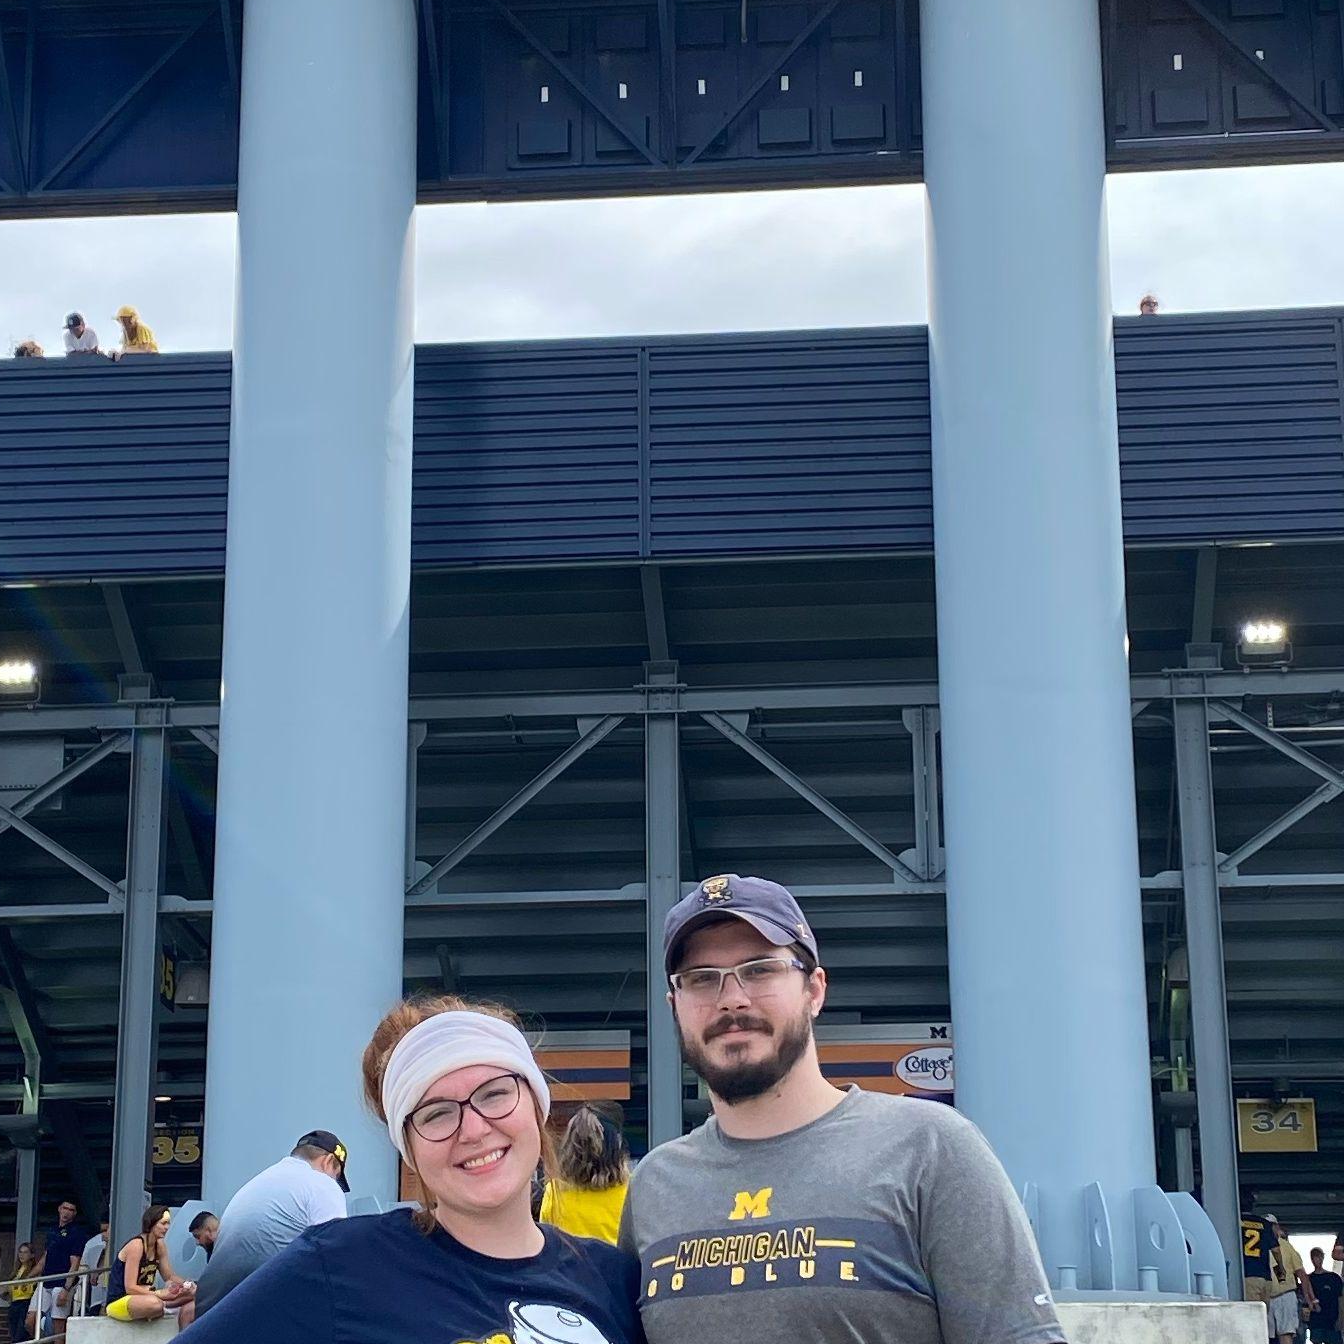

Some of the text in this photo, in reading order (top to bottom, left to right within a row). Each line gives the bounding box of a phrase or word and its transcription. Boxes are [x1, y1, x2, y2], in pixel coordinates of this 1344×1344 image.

[929, 1026, 948, 1039] M
[904, 1055, 951, 1081] Cottage
[1251, 1111, 1304, 1133] 34
[152, 1136, 201, 1164] 35
[728, 1187, 774, 1221] M
[675, 1226, 817, 1271] MICHIGAN
[1244, 1229, 1261, 1257] 2
[647, 1259, 860, 1298] GO BLUE
